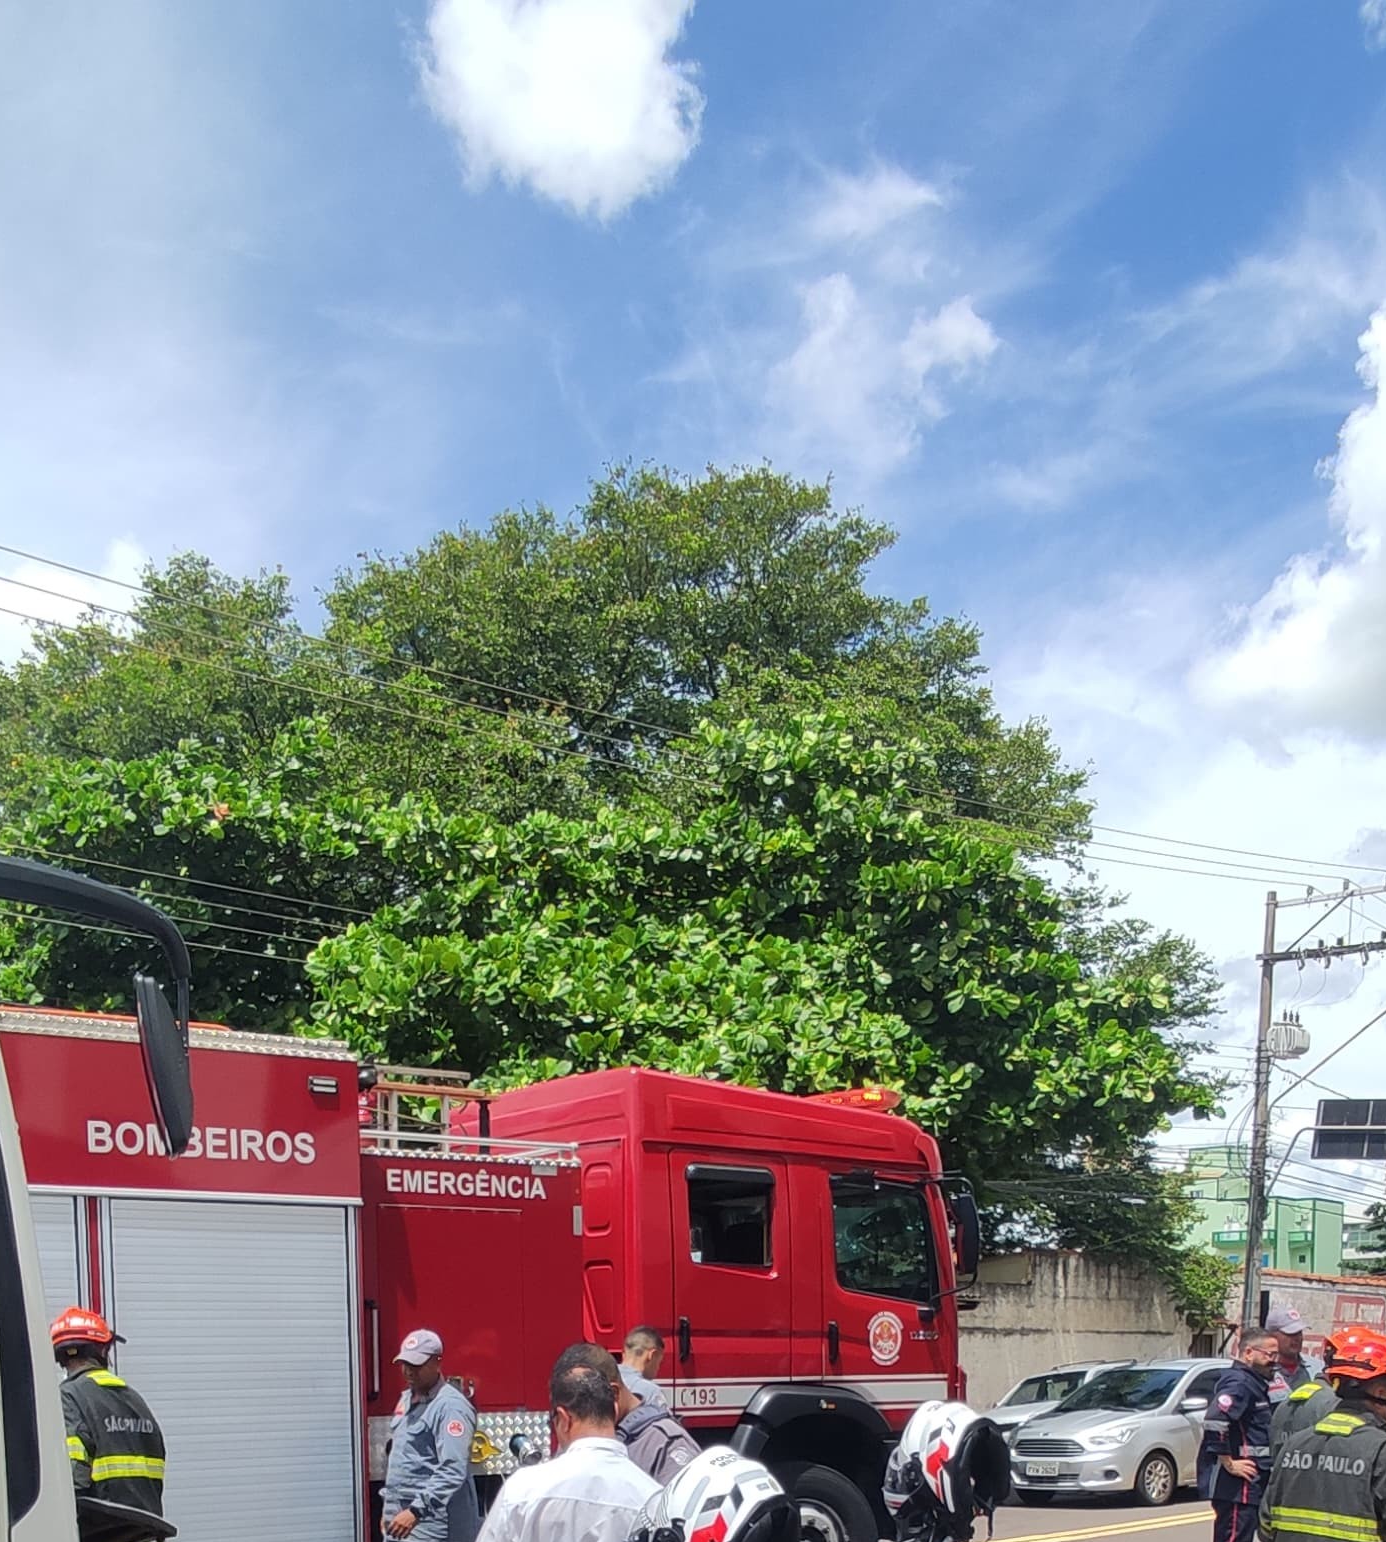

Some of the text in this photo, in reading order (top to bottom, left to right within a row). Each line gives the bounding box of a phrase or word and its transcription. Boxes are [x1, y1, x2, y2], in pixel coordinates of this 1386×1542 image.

[386, 1167, 547, 1200] EMERGÊNCIA
[690, 1388, 717, 1406] 193
[1281, 1449, 1365, 1476] SÃO PAULO
